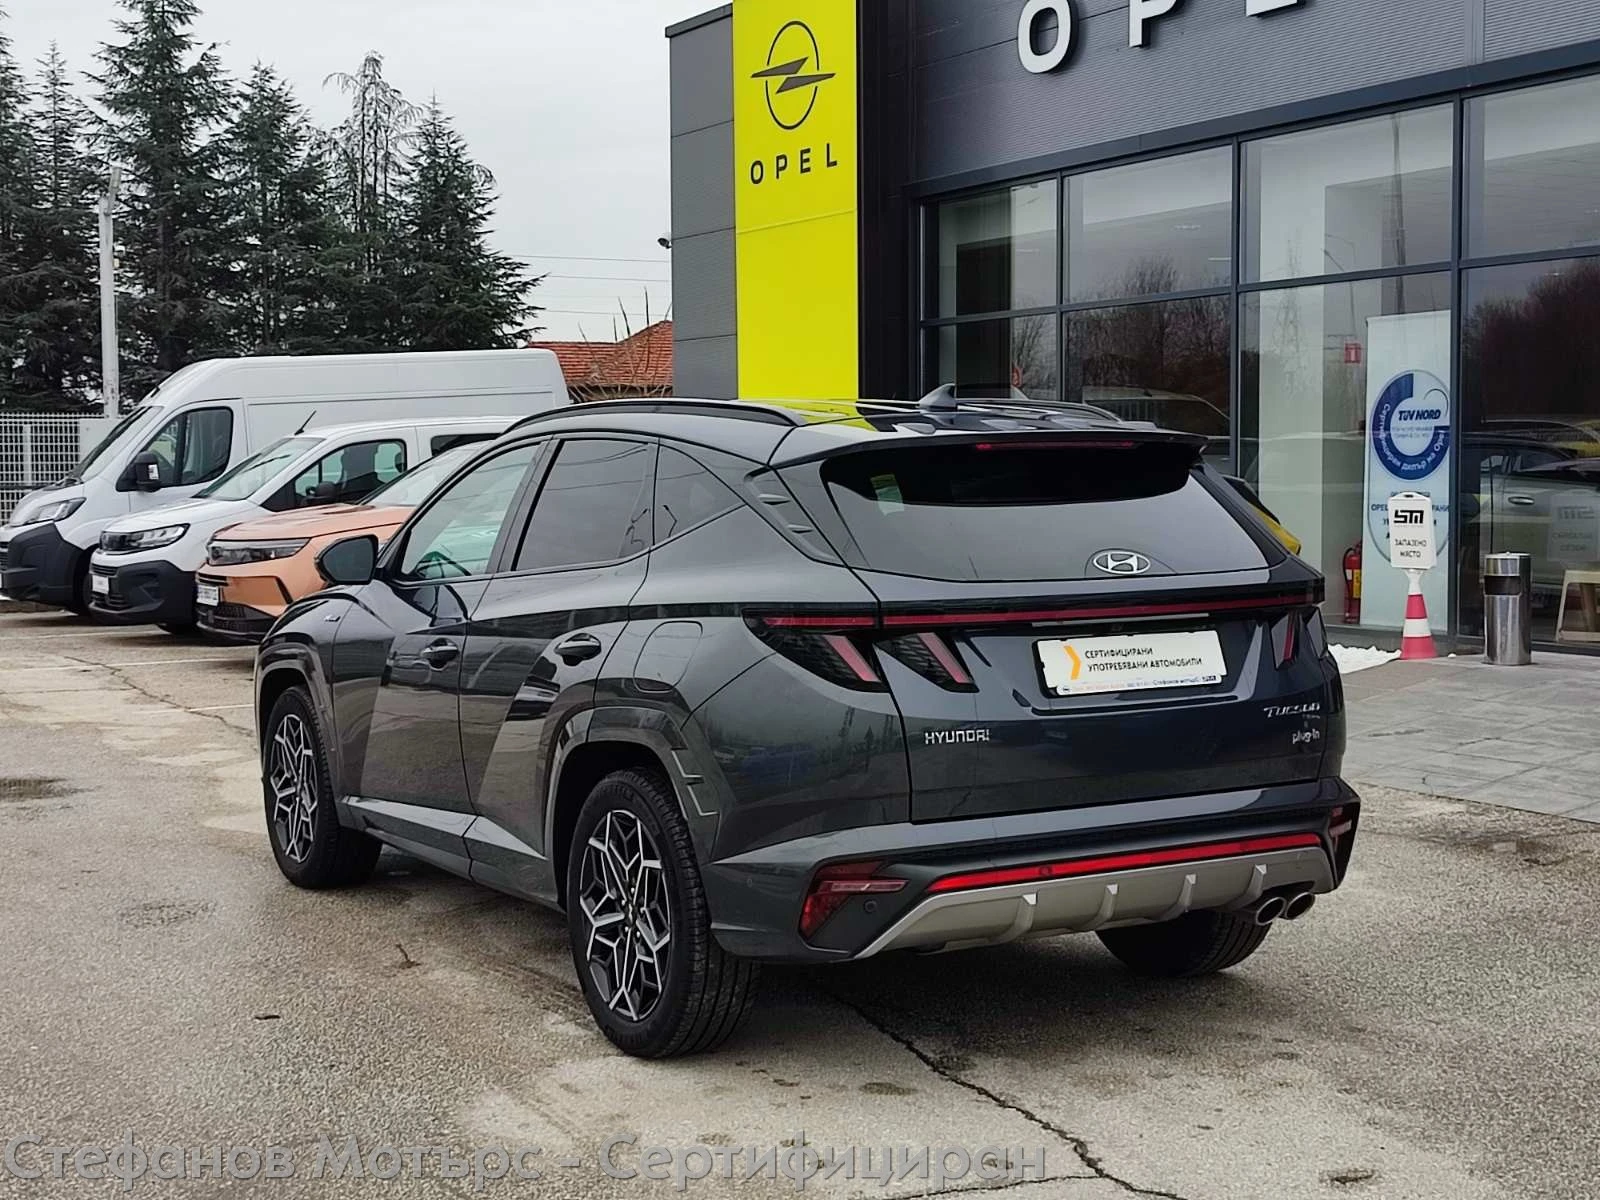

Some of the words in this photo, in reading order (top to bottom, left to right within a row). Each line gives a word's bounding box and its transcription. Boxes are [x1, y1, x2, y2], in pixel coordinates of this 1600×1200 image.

[751, 143, 838, 185] OPEL
[1415, 409, 1441, 420] NORD
[1395, 539, 1427, 547] ЗАПАЗЕНО
[1400, 550, 1421, 558] МЯСТО
[1085, 648, 1153, 659] СЕРТИФИЦИРАНИ
[1088, 661, 1149, 672] УПОТРЕБЯВАНИ
[1150, 658, 1202, 669] АВТОМОБИЛИ
[925, 729, 990, 744] HYUNDAI
